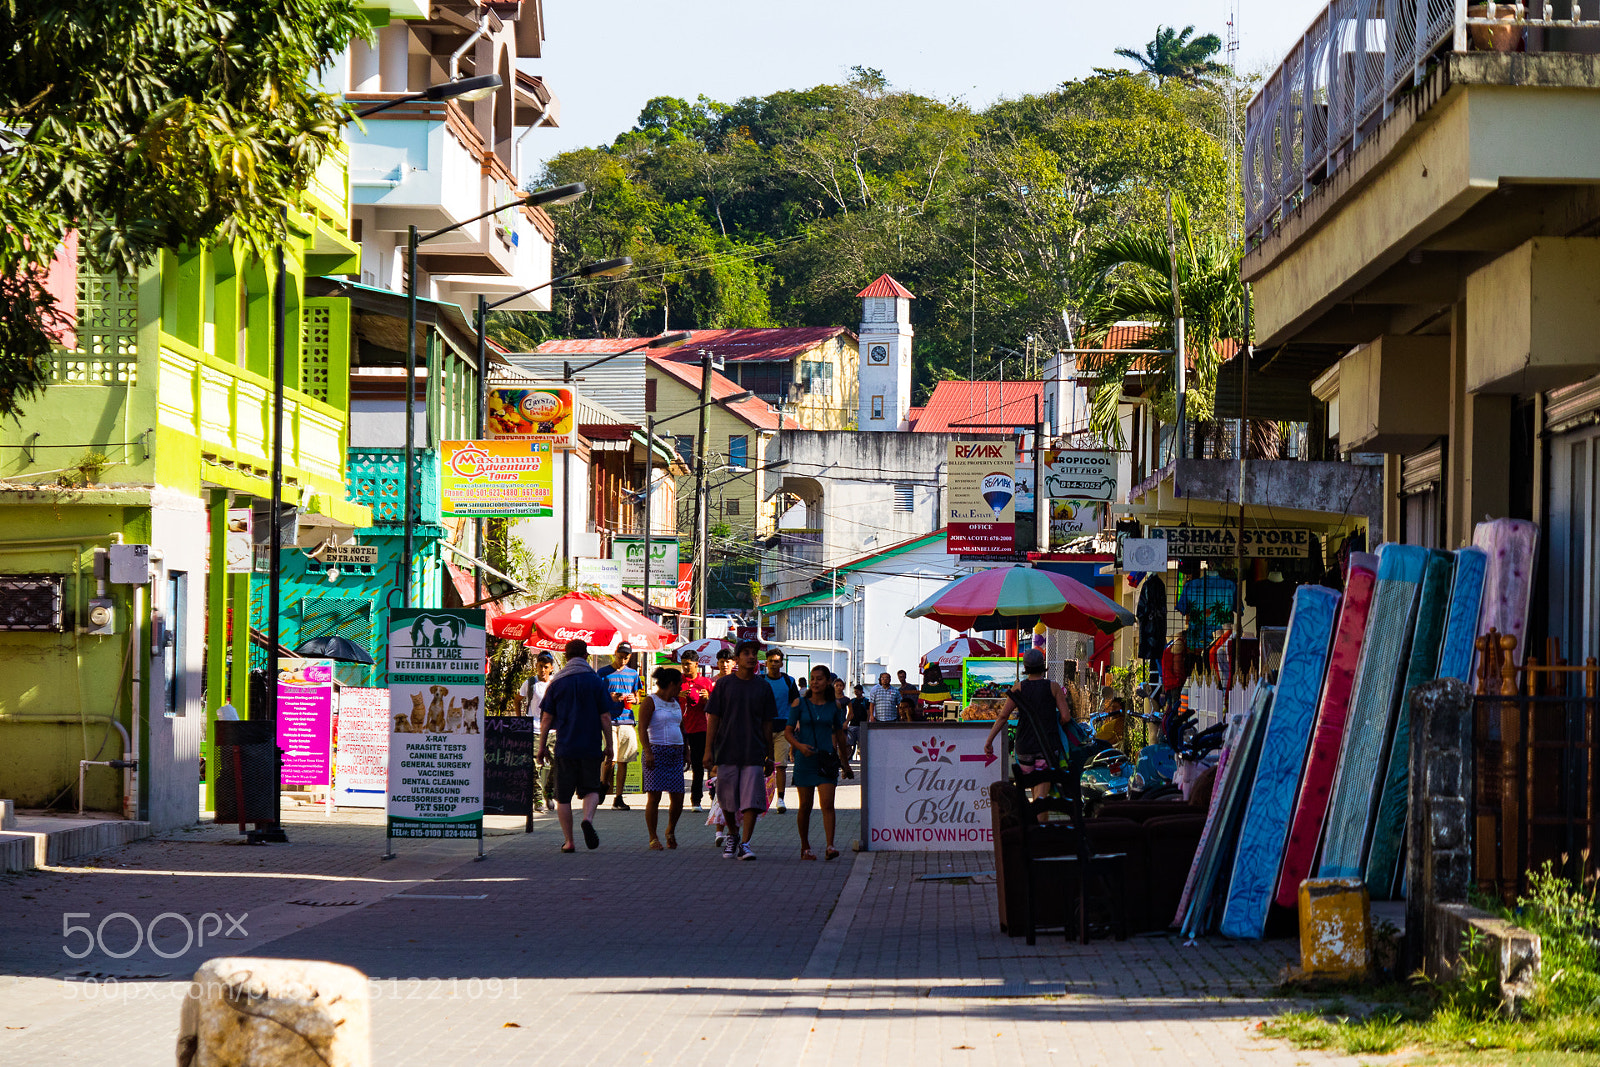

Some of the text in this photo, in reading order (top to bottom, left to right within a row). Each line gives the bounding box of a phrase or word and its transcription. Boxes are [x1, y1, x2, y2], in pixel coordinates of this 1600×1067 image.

[955, 444, 1002, 458] RE/MAX
[458, 453, 541, 464] Maximum
[1053, 456, 1110, 465] TROPICOOL
[475, 464, 539, 472] Adventure
[1243, 530, 1307, 544] STORE
[1168, 545, 1236, 555] HOLESALE
[1258, 546, 1300, 556] RETAIL
[554, 628, 595, 642] Coca-Cola
[437, 649, 462, 658] PLACE
[395, 661, 479, 670] VETERINARY CLINIC
[895, 767, 980, 810] Maya
[905, 797, 981, 824] Bella
[872, 828, 994, 842] DOWNTOWN HOTE
